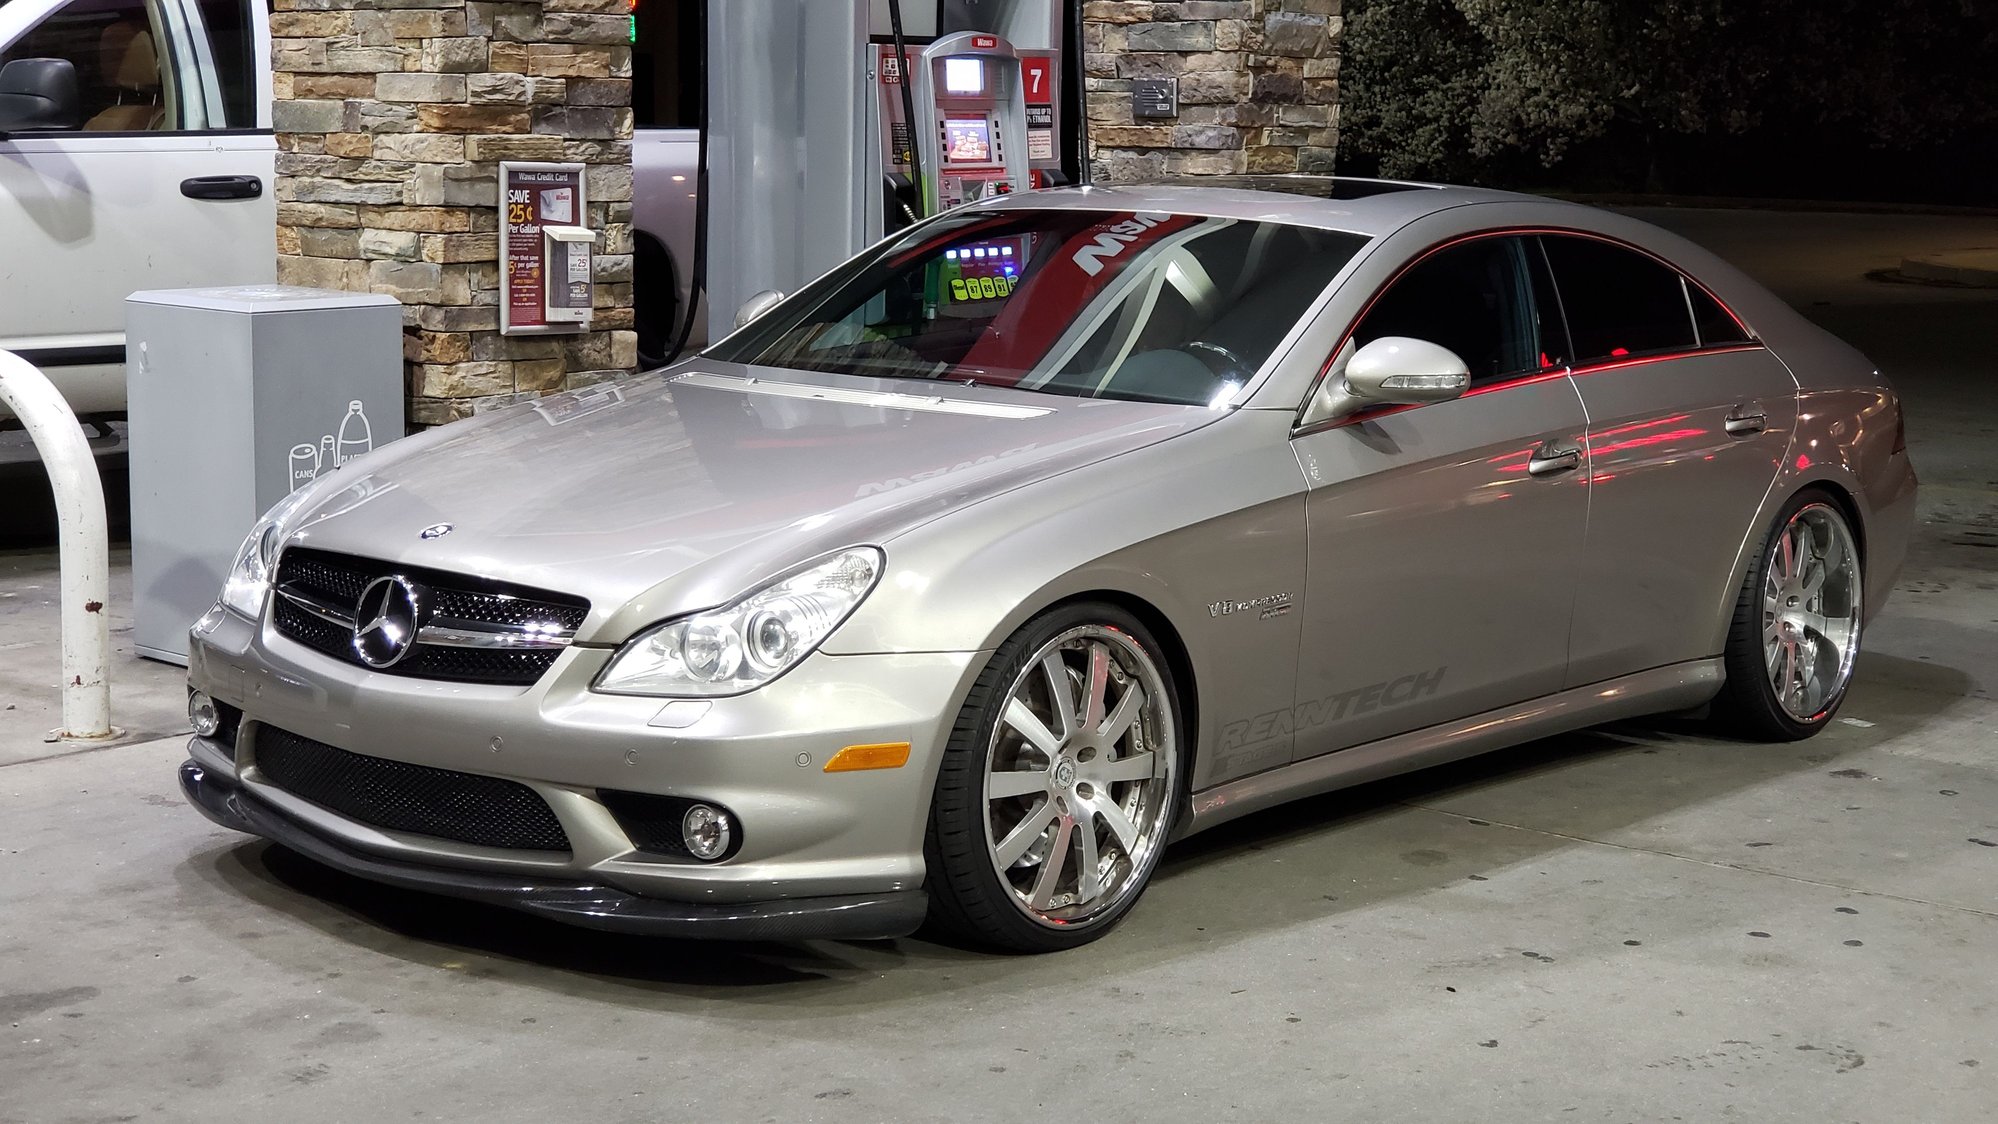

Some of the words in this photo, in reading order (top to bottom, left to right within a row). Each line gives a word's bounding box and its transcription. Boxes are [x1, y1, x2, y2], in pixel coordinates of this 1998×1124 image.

[977, 38, 993, 47] Wawa
[1030, 68, 1042, 94] 7
[1032, 115, 1052, 123] ETHANOL
[518, 173, 536, 181] Wawa
[537, 173, 554, 181] Credit
[555, 173, 568, 182] Card
[508, 190, 530, 203] SAVE
[508, 224, 519, 233] Per
[969, 285, 978, 294] 87
[983, 284, 993, 293] 89
[997, 284, 1006, 292] 91
[295, 469, 314, 479] CANS
[1207, 599, 1233, 617] V8
[1215, 665, 1449, 756] RENNTECH
